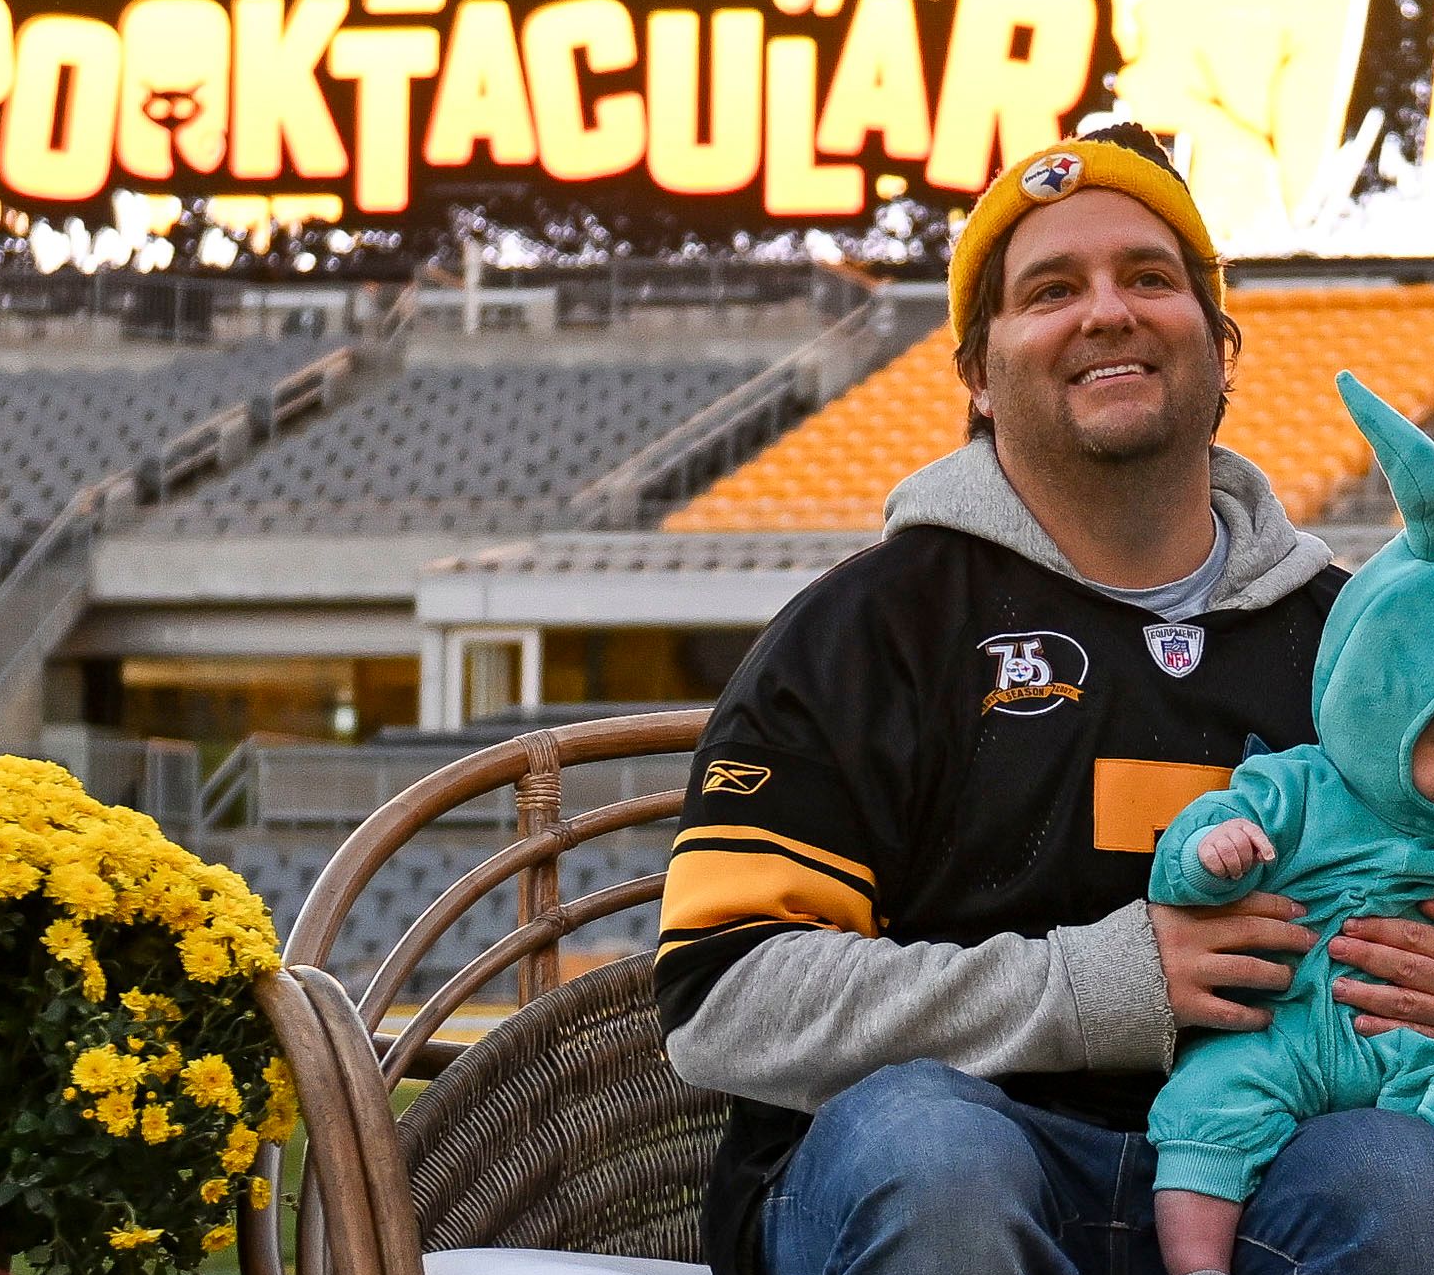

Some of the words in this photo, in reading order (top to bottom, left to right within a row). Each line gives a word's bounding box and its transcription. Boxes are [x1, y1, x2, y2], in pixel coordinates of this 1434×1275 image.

[1150, 628, 1198, 640] EQUIPMENT
[1166, 651, 1191, 668] NFL
[1006, 687, 1045, 701] SEASON
